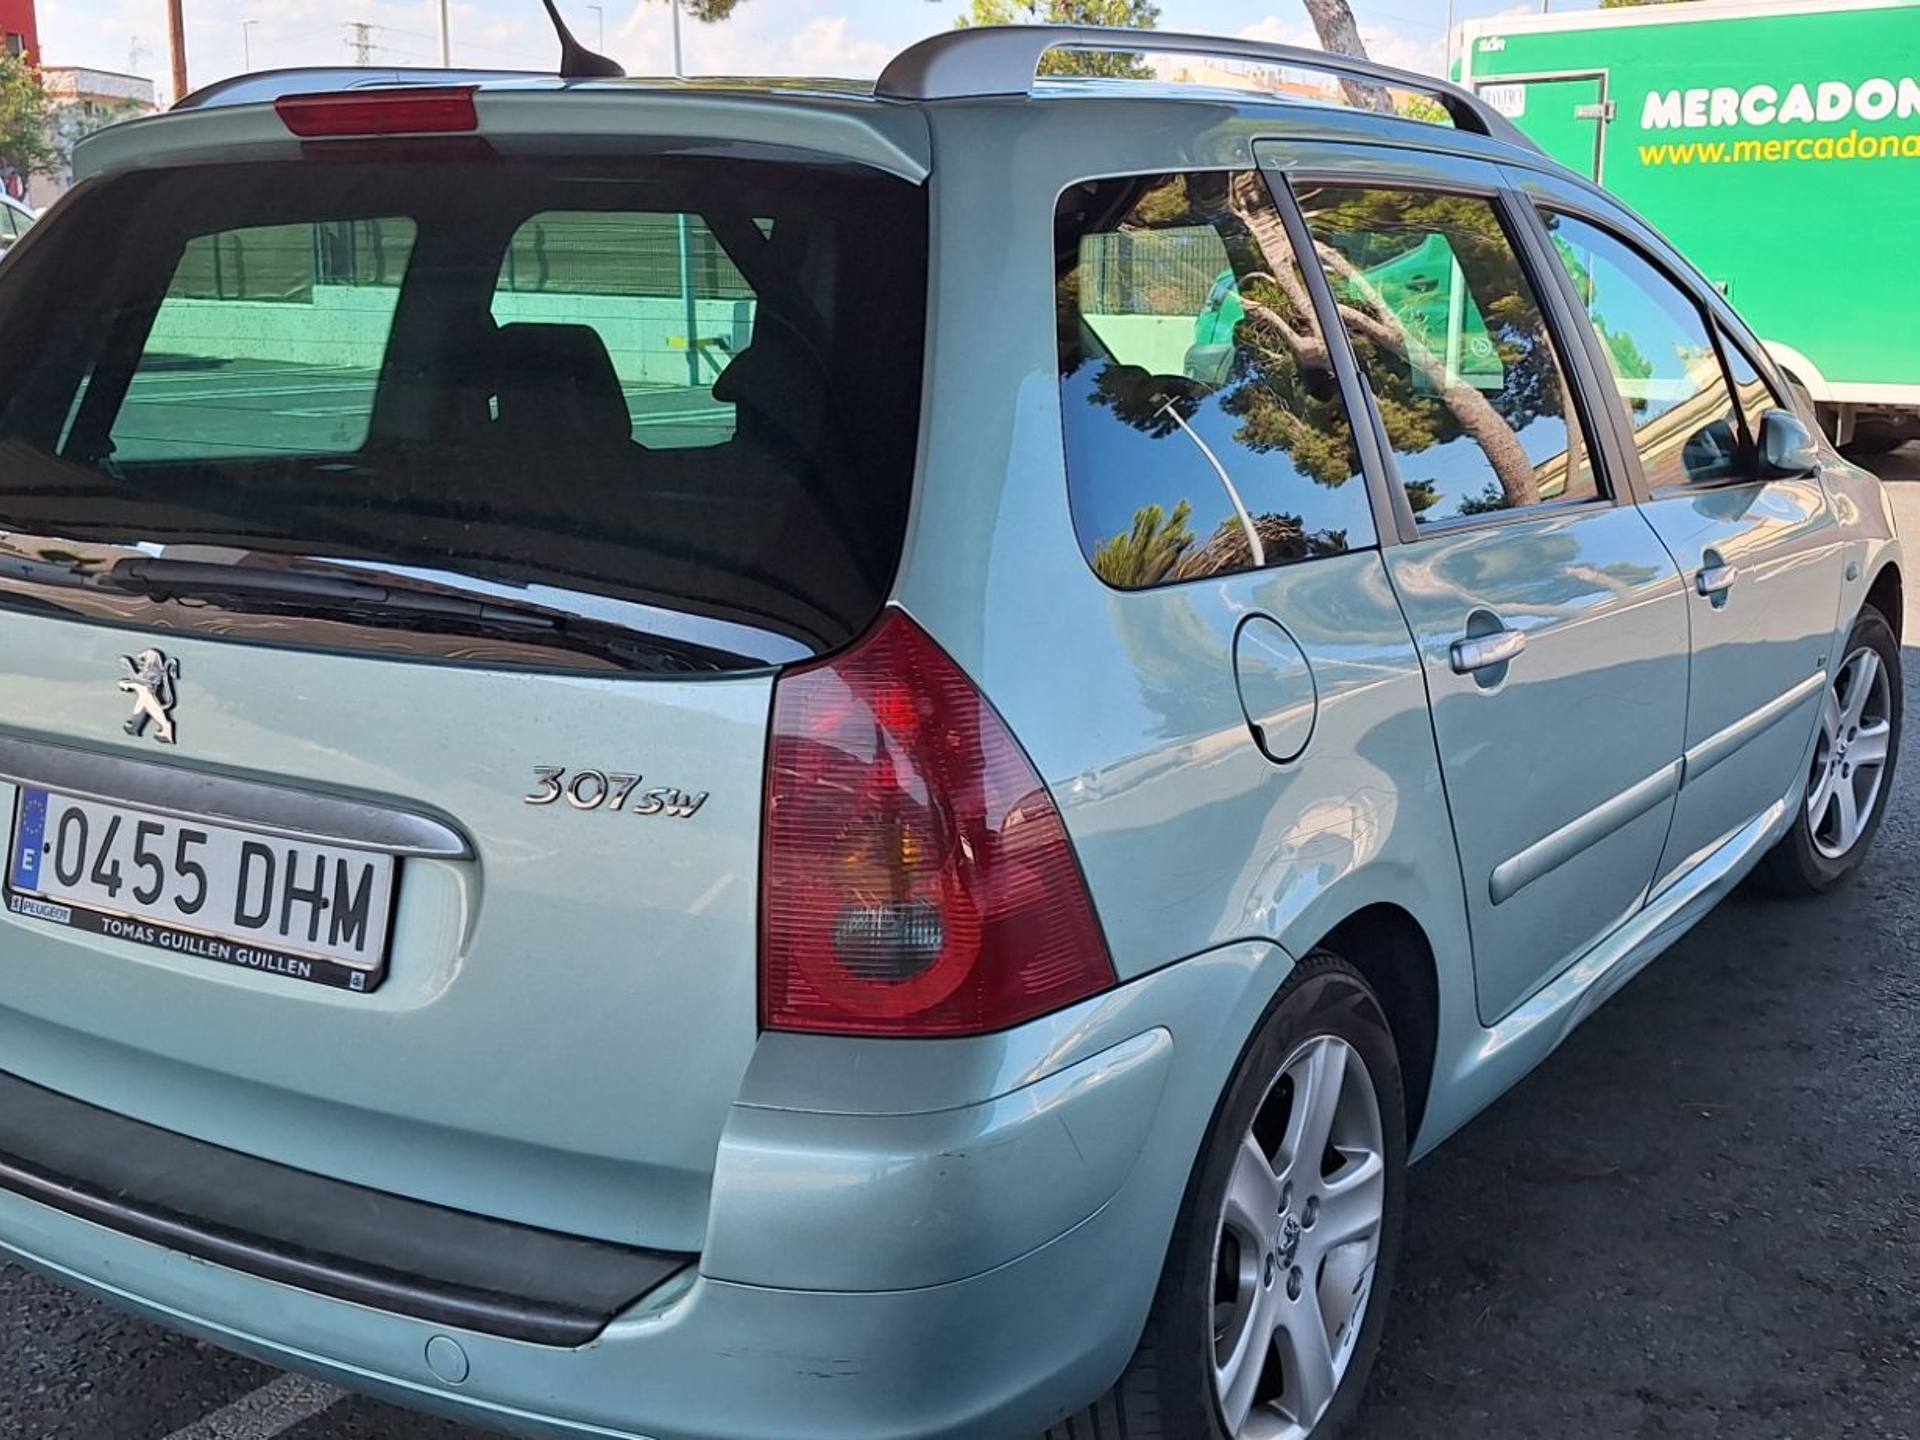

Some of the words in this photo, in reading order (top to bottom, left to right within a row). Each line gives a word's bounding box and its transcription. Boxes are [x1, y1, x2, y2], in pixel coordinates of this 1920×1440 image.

[1639, 129, 1920, 165] www.mercadona
[22, 848, 36, 870] E
[54, 806, 208, 915] 0455
[233, 840, 374, 952] DHM
[23, 901, 69, 920] PEUGEOT
[101, 917, 155, 943] TOMAS
[159, 932, 231, 960] GUILLEN
[235, 949, 312, 978] GUILLEN
